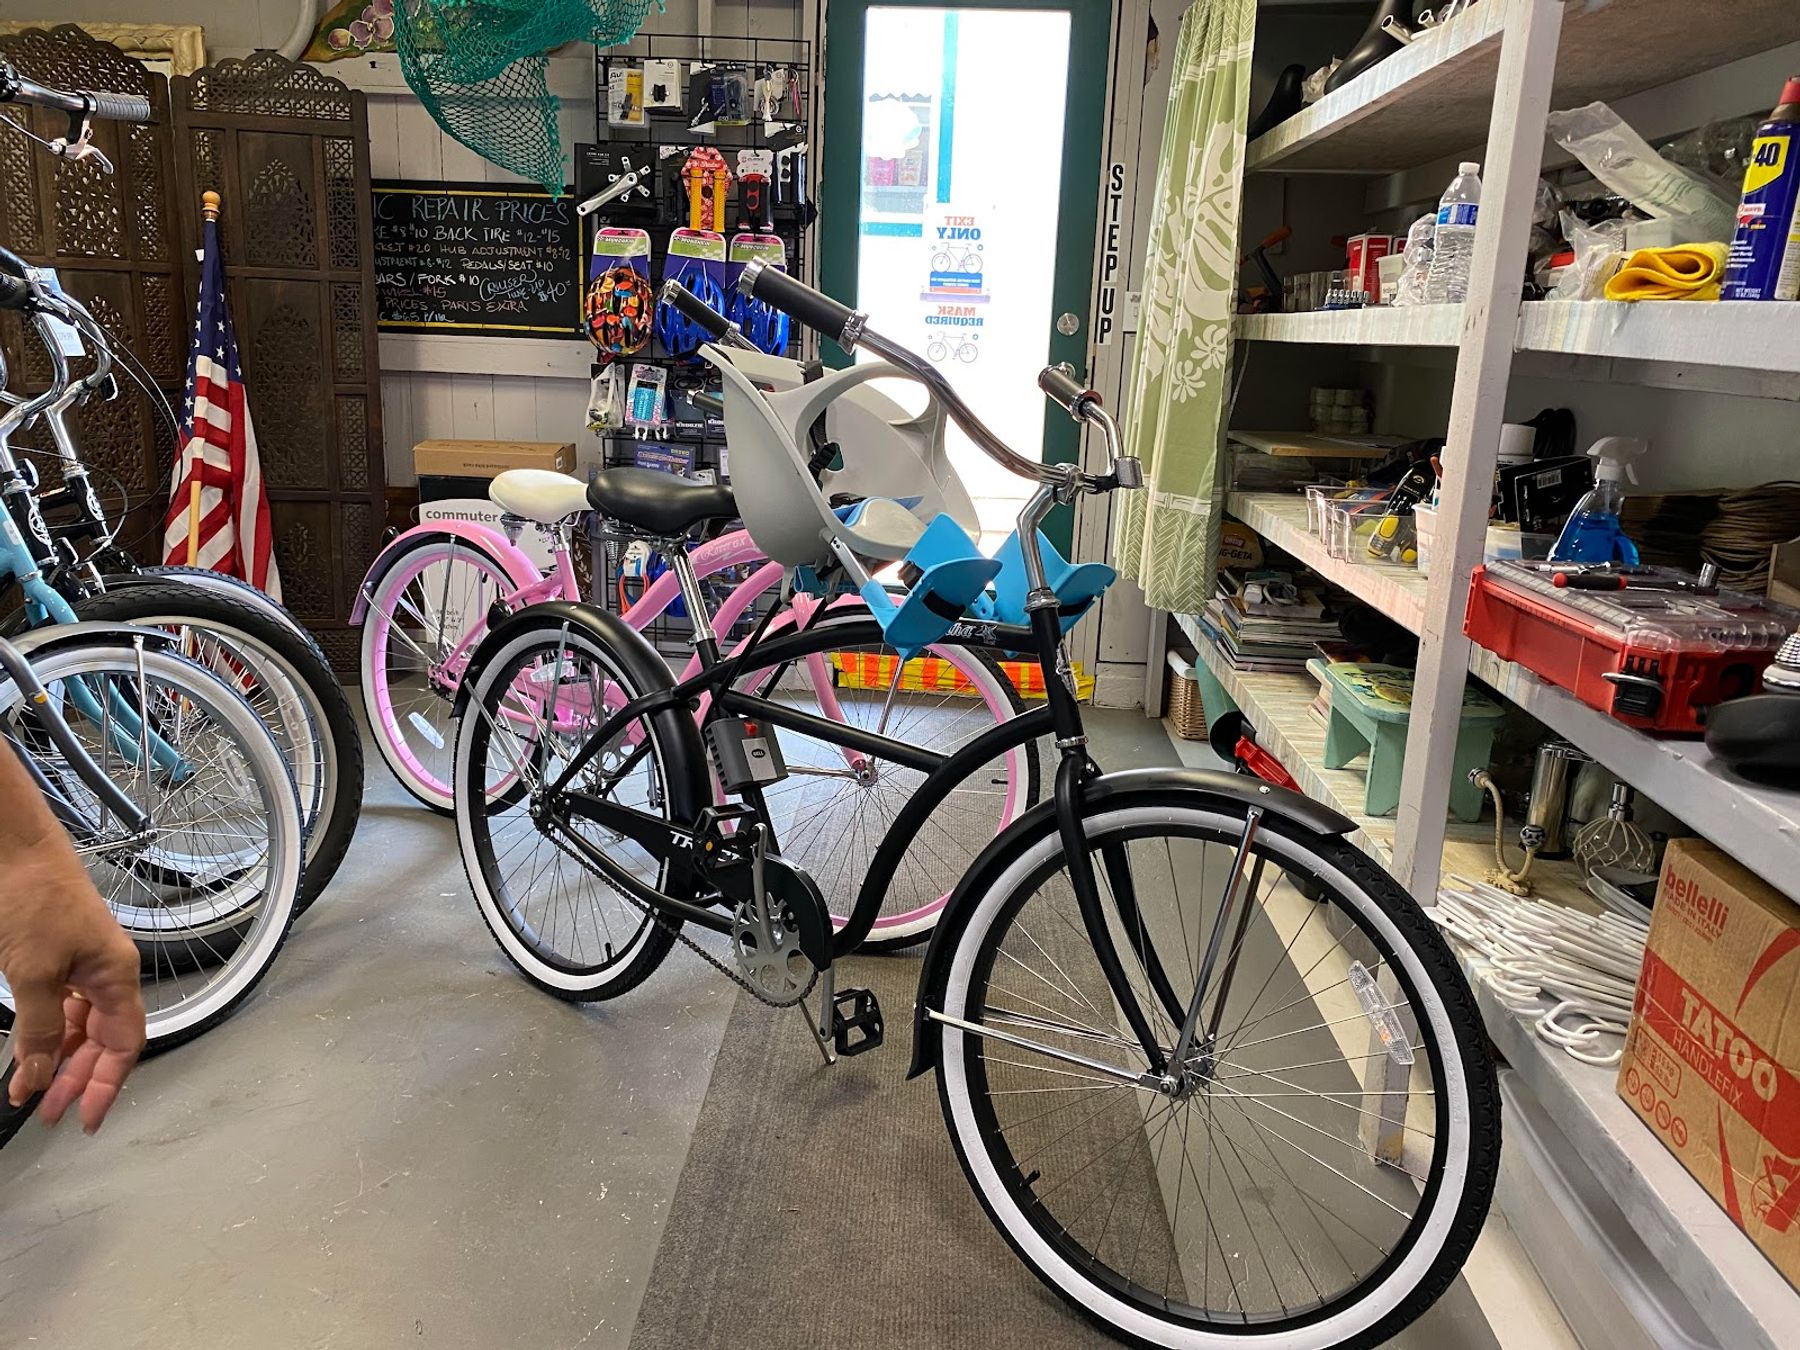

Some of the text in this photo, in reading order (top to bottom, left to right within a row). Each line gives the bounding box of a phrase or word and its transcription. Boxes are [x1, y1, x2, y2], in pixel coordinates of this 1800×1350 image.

[1755, 142, 1782, 167] 40
[412, 195, 490, 222] REPAIR
[495, 200, 570, 226] PRICES
[433, 225, 478, 241] BACK
[483, 227, 511, 244] TIRE
[440, 243, 467, 255] HUB
[472, 246, 544, 258] ADJUSTMENT
[1099, 164, 1124, 344] STEP UP
[417, 273, 457, 286] FORK
[384, 297, 429, 312] PRICES
[440, 300, 482, 312] PARTS
[485, 300, 529, 313] EXTRA
[426, 510, 499, 522] commuter
[1664, 863, 1730, 931] bellelli
[1697, 915, 1722, 939] ITALY
[1680, 986, 1778, 1102] TATOO
[1672, 1029, 1744, 1110] HANDLEFIX
